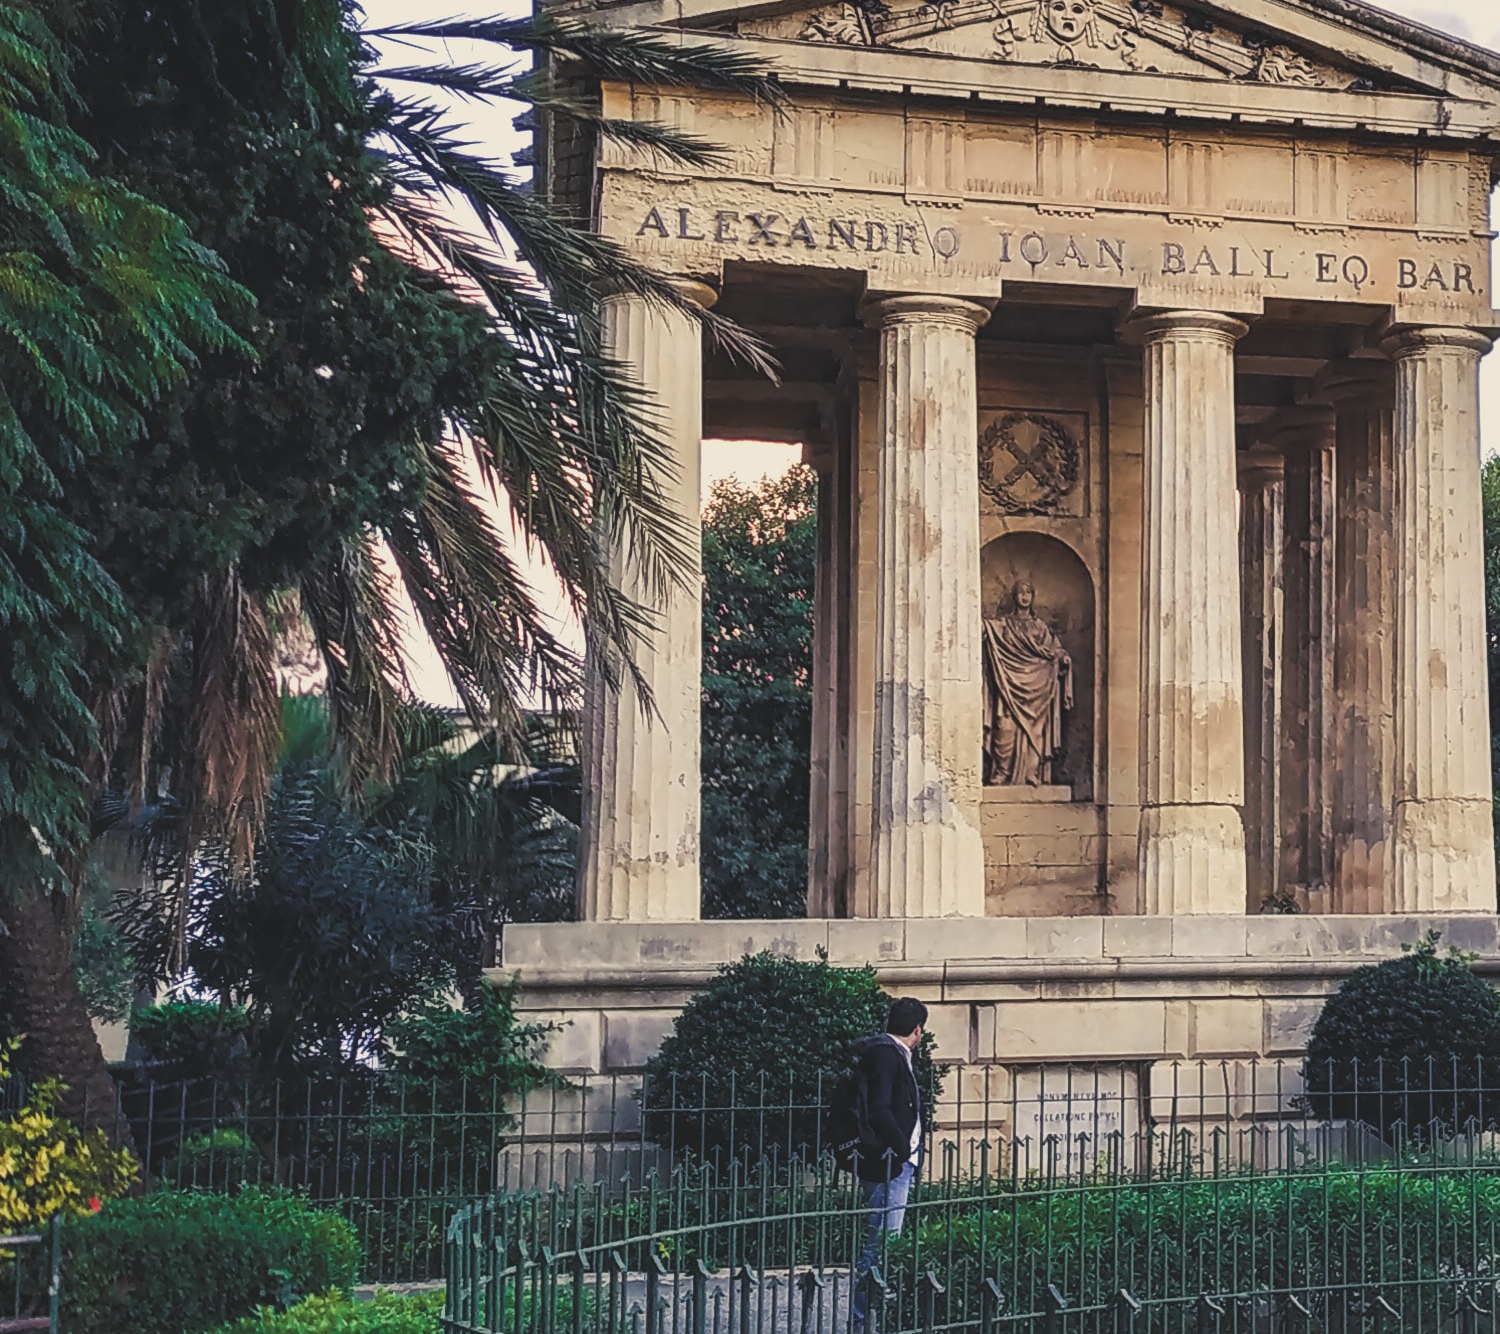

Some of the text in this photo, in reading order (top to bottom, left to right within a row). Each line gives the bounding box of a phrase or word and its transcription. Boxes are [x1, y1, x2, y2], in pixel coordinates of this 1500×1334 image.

[636, 206, 961, 262] ALEXANDRO
[1161, 242, 1289, 278] BALL
[1315, 253, 1375, 290] EQ.
[1397, 258, 1483, 294] BAR.
